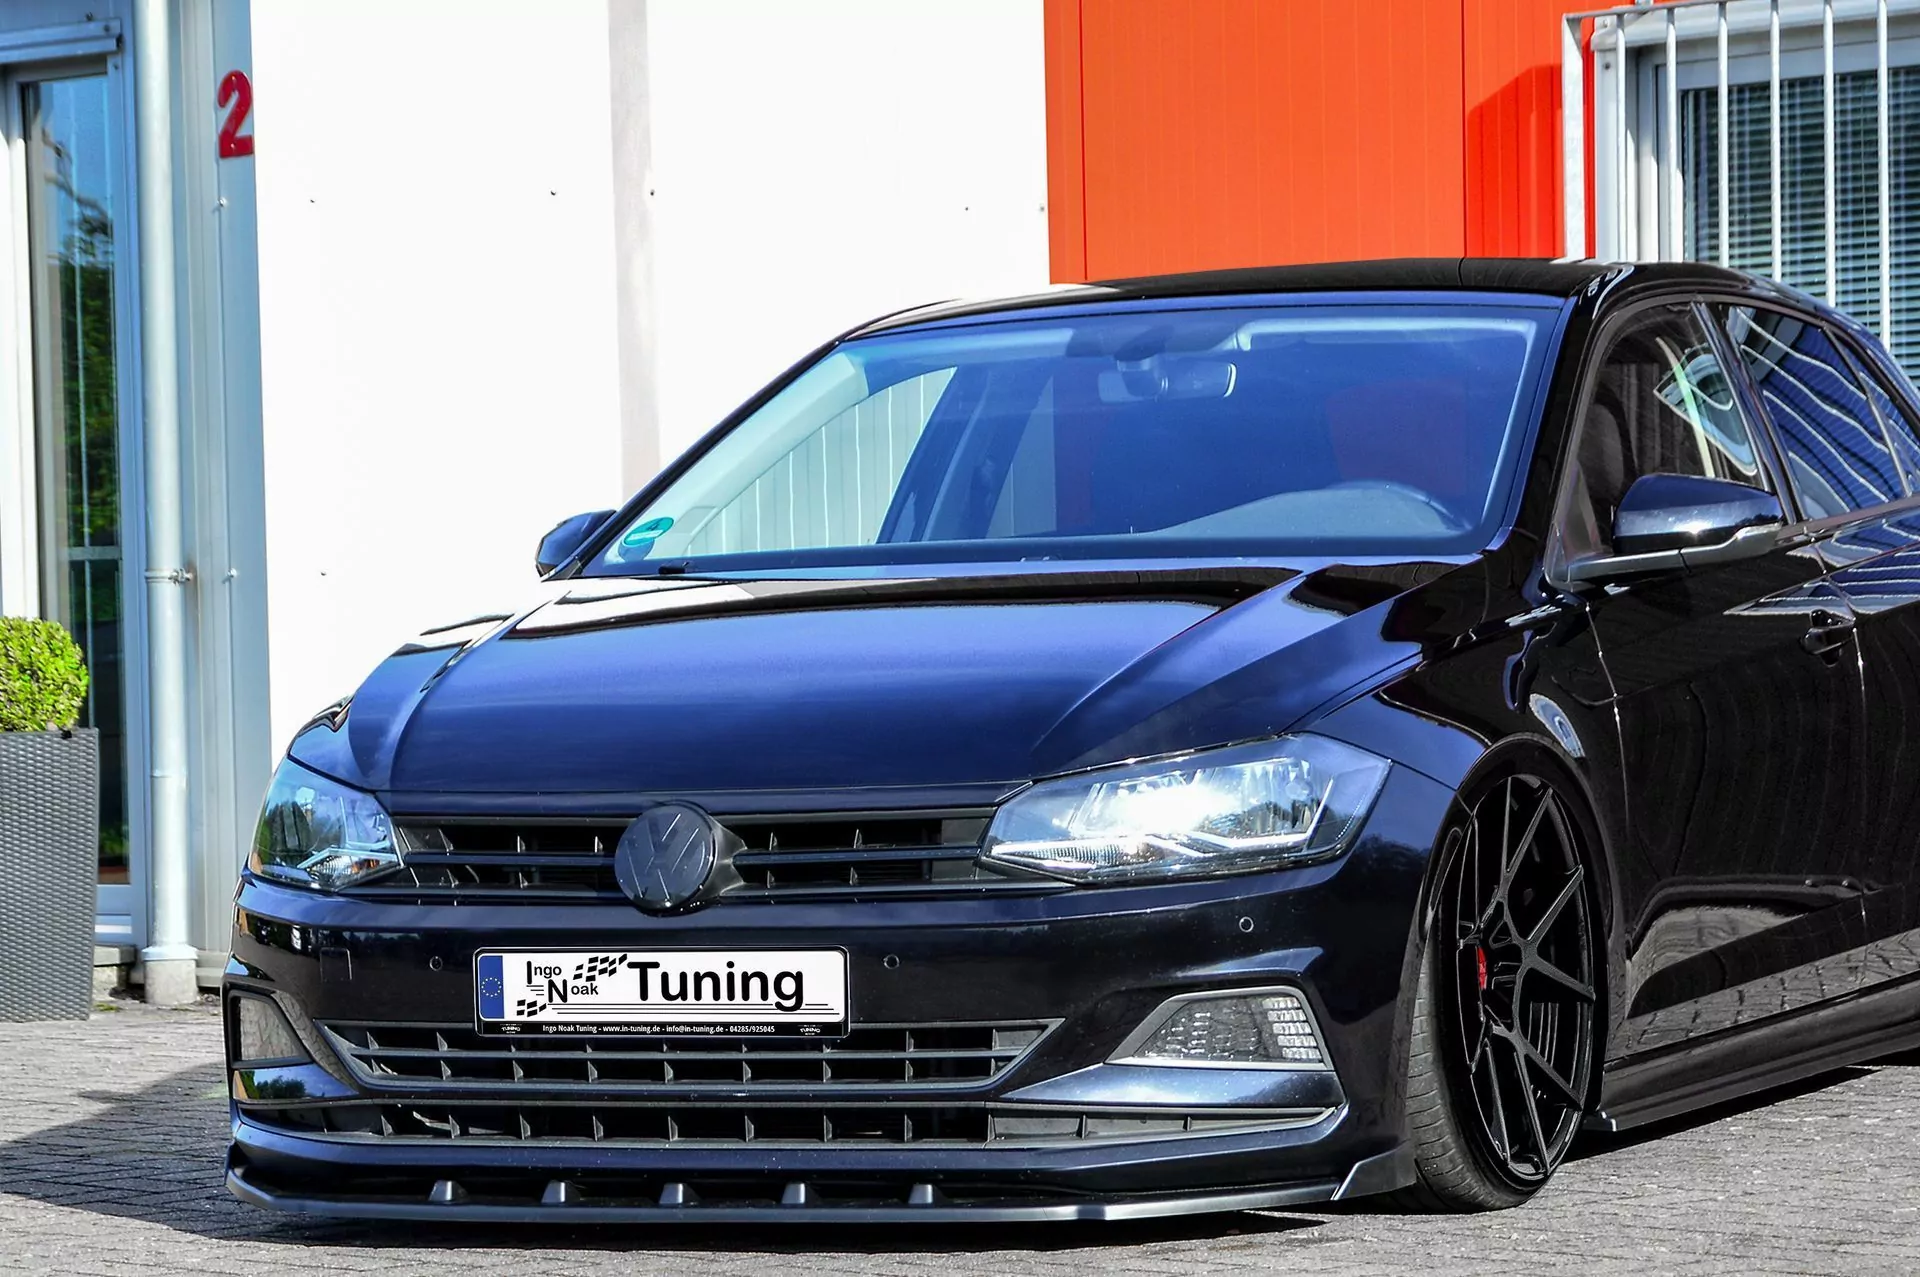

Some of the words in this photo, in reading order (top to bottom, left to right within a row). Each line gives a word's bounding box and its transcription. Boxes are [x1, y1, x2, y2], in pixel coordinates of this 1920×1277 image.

[217, 69, 254, 159] 2
[526, 960, 562, 985] Ingo
[547, 978, 599, 1004] Noak
[626, 960, 804, 1012] Tuning
[542, 1024, 557, 1034] Ingo
[558, 1024, 575, 1032] Noak
[576, 1024, 598, 1034] Tuning
[602, 1024, 661, 1034] www.in-tuning.de
[666, 1024, 724, 1034] info@in-tuning.de
[729, 1025, 776, 1033] 04285/925045
